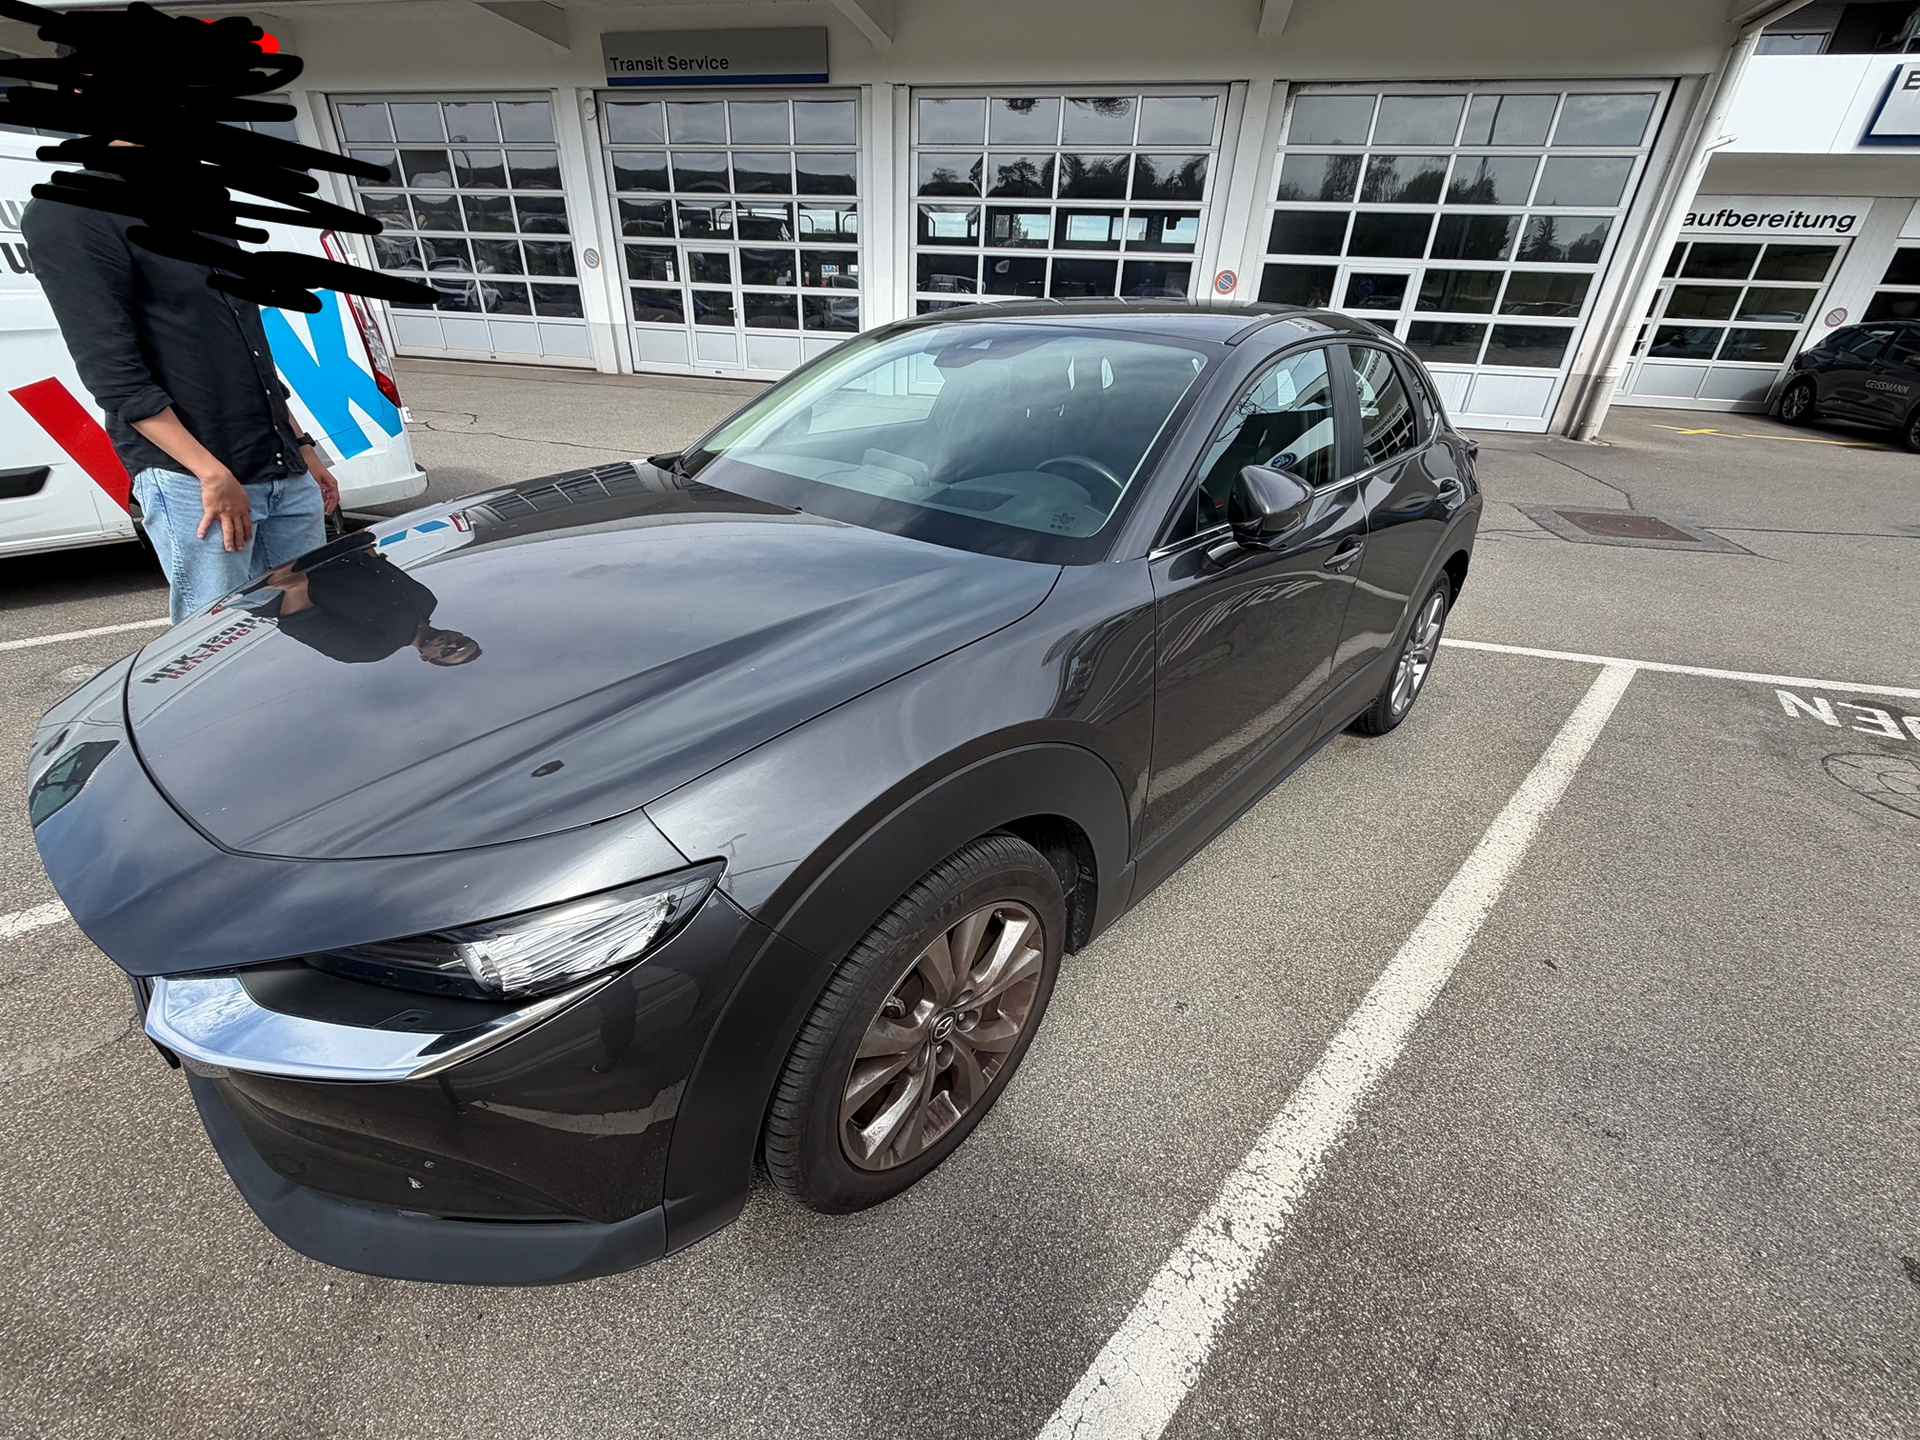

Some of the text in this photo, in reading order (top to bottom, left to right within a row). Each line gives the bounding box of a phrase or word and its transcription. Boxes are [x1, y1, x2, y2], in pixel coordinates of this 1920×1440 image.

[609, 55, 730, 71] Transit Service
[1683, 209, 1857, 234] aufbereitung
[1865, 379, 1910, 395] GEISSMANN
